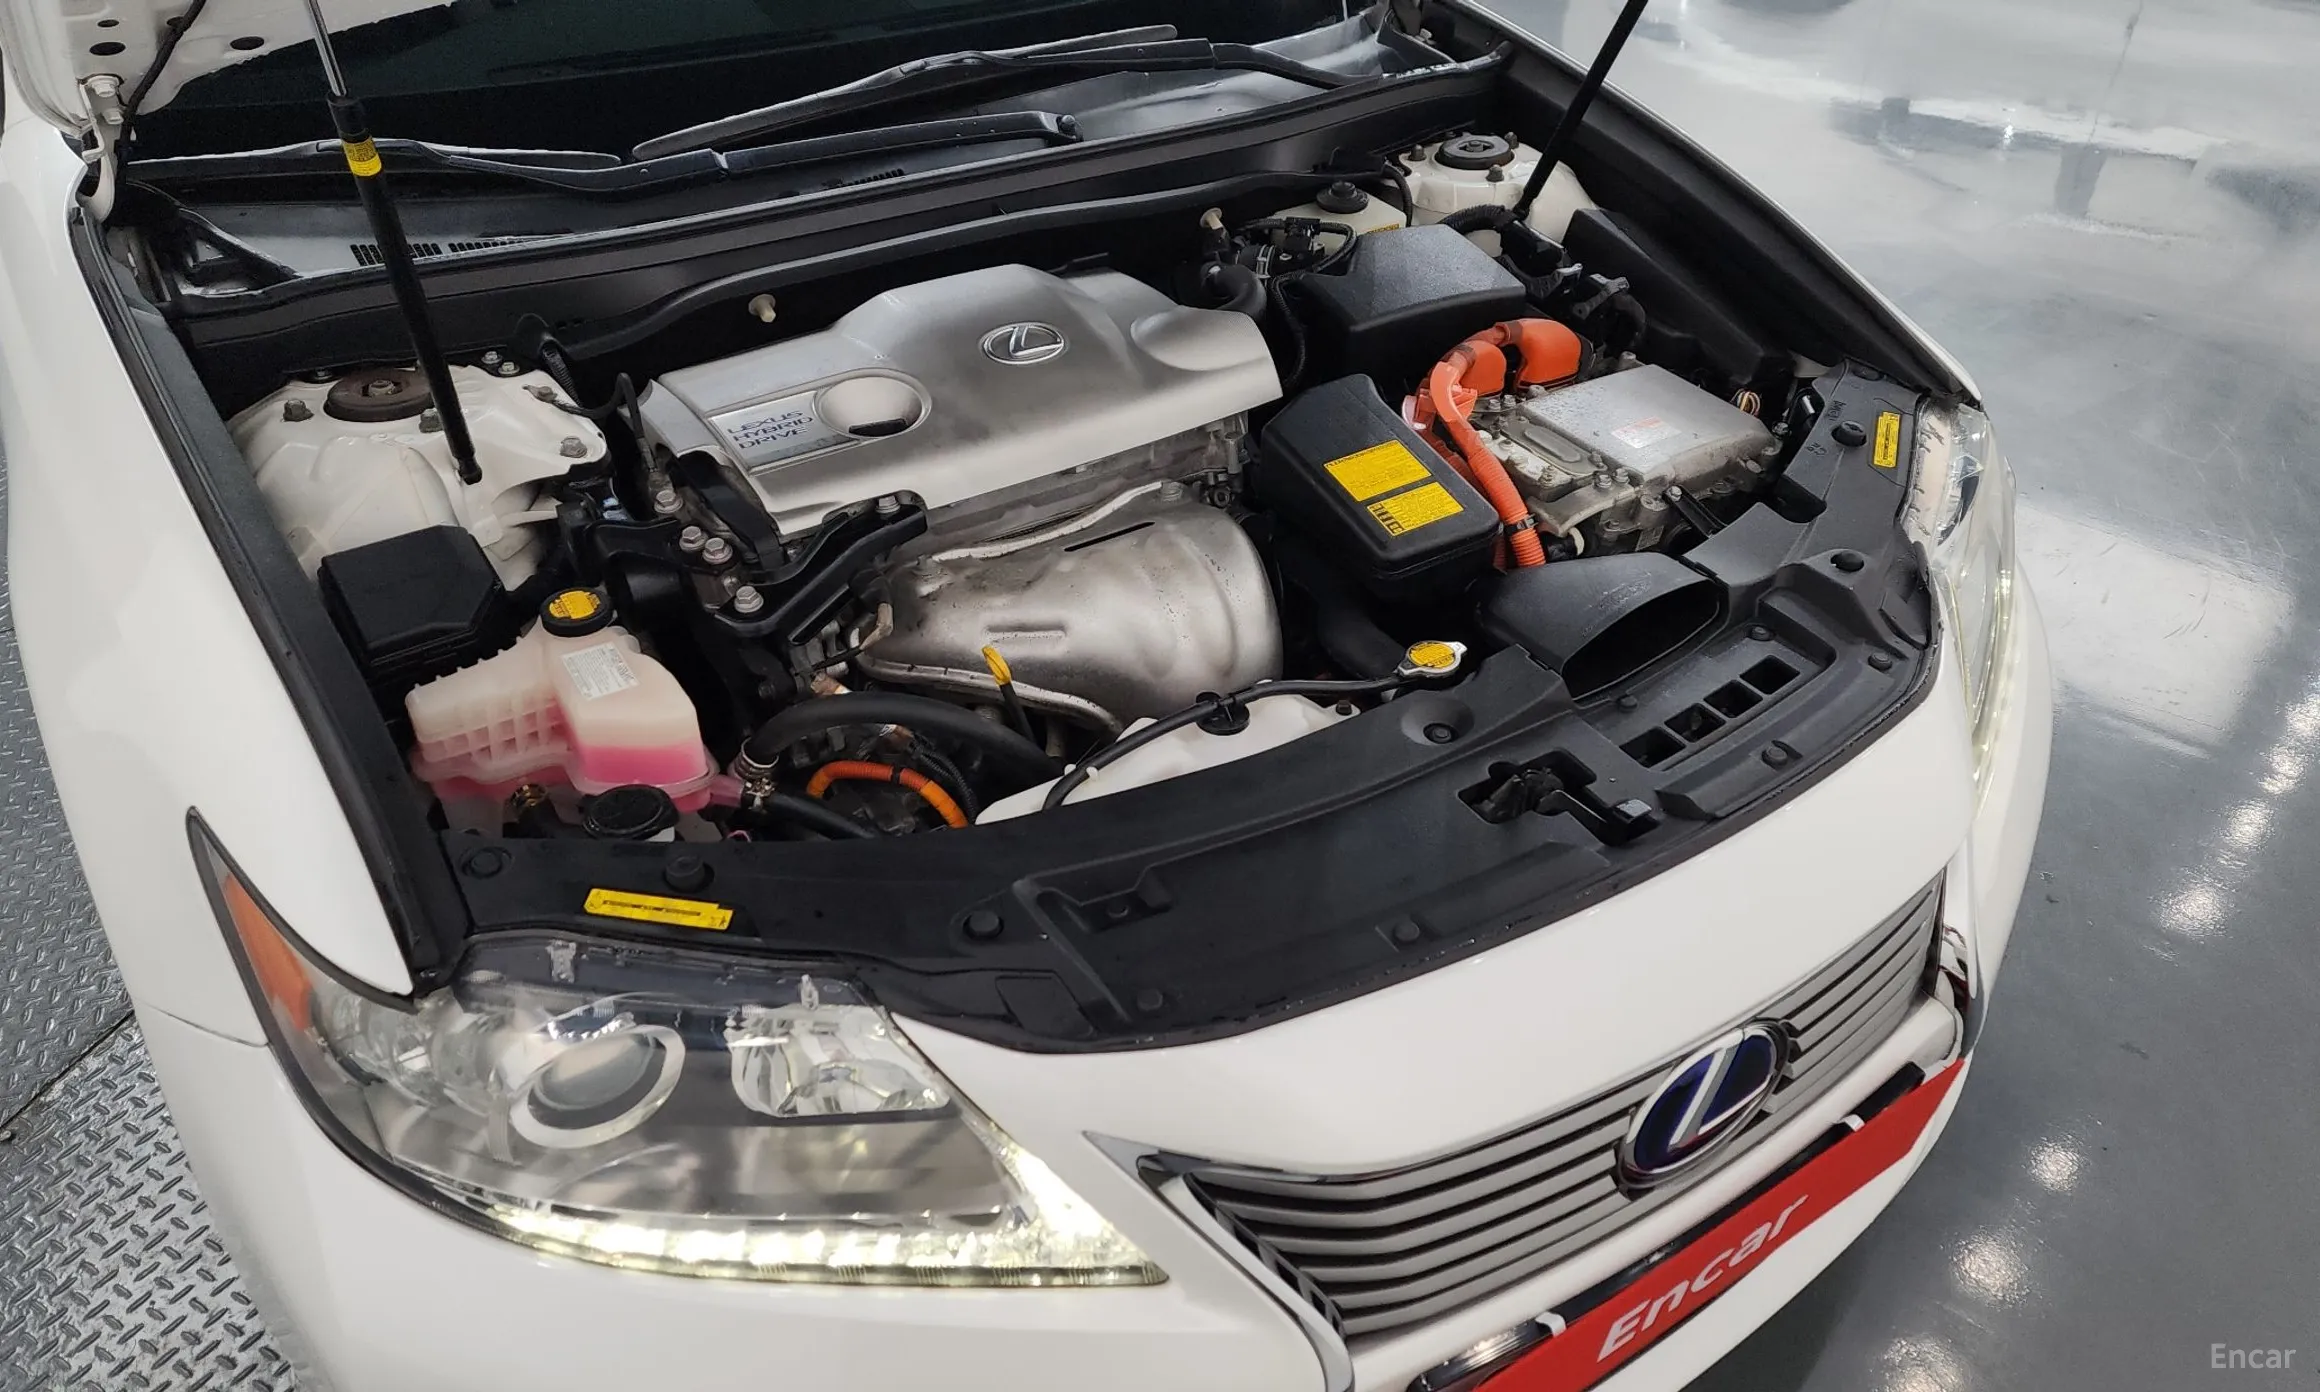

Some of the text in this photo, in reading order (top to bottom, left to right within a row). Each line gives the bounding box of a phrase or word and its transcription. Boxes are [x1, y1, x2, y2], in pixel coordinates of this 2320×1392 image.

[728, 411, 803, 433] LEXUS
[733, 417, 813, 441] HYBRID
[739, 427, 807, 449] DRIVE
[1597, 1194, 1809, 1363] Encar
